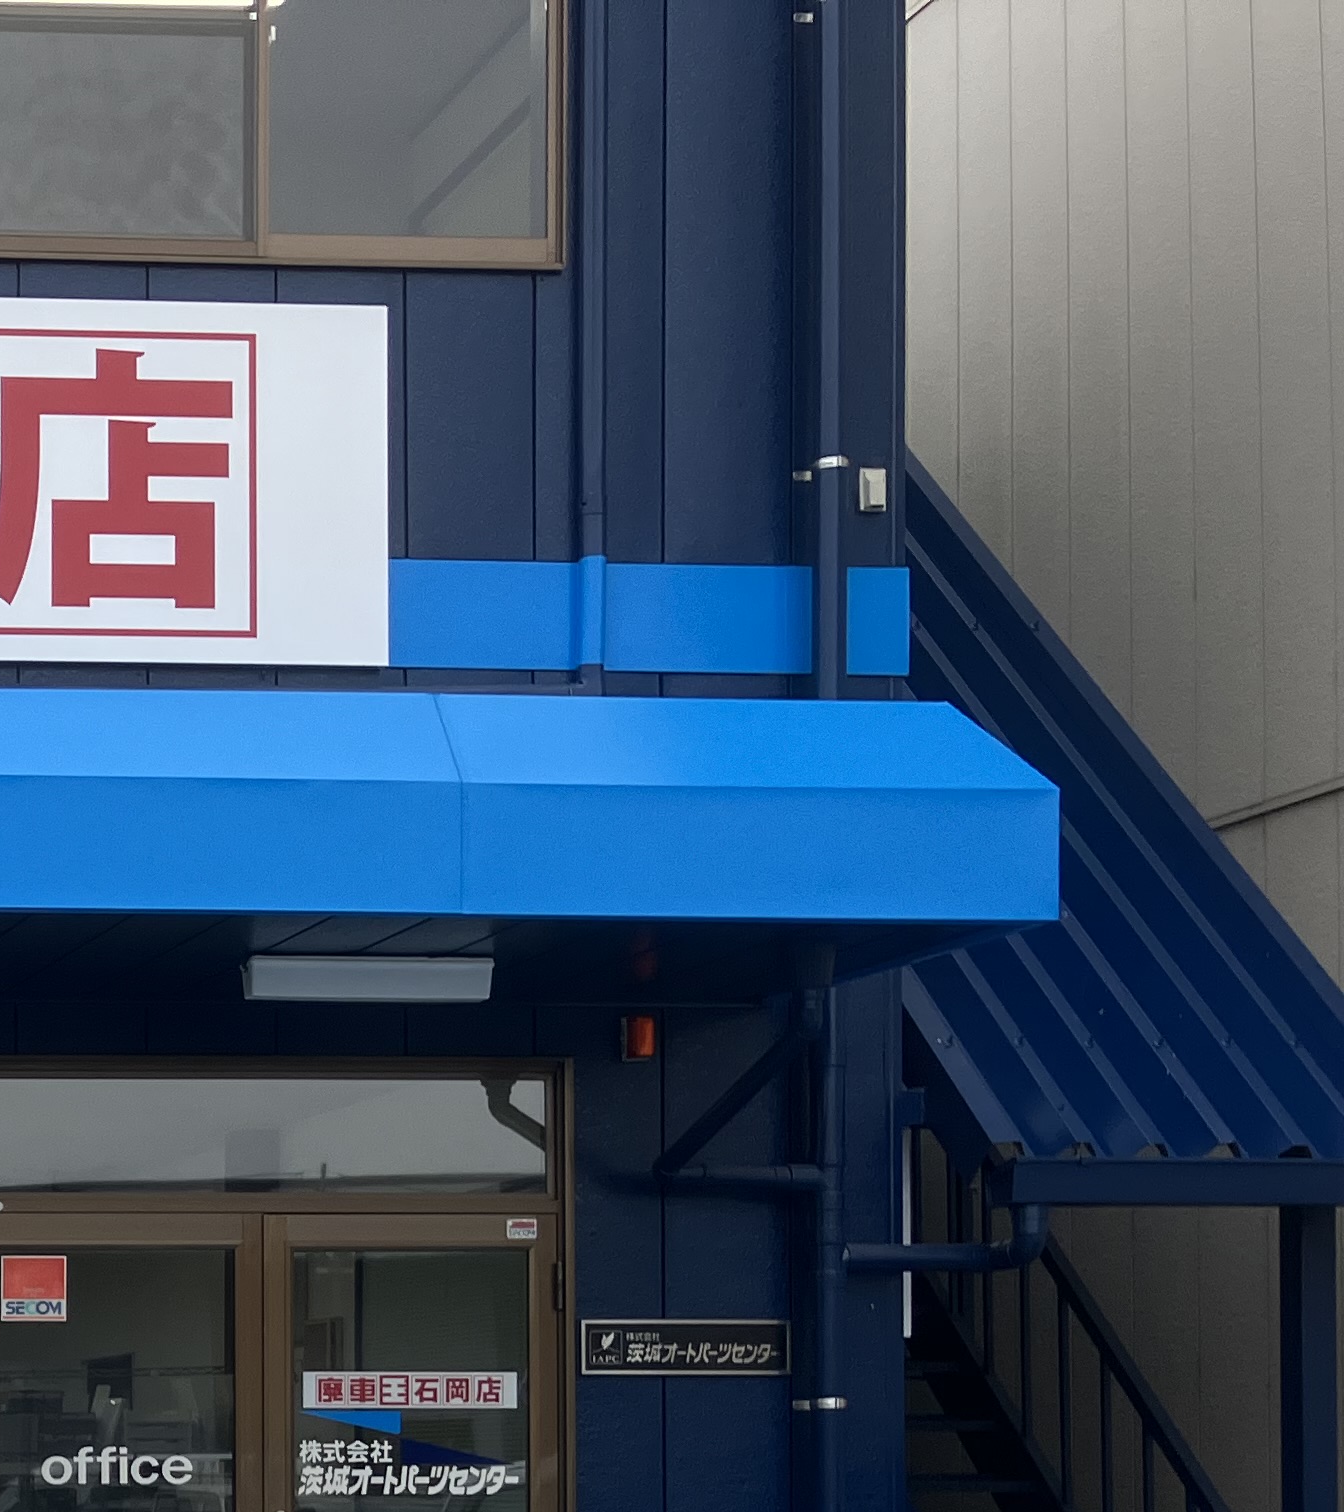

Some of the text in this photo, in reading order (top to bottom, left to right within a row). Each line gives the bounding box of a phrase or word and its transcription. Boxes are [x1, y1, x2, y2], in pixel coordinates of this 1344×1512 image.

[5, 1301, 62, 1315] SECOM
[626, 1342, 778, 1364] 茨城オートパーツセンター
[318, 1376, 502, 1404] 廃車王石岡店
[298, 1440, 393, 1463] 株式会社
[41, 1446, 193, 1485] office
[298, 1464, 519, 1495] 茨城オートパーツセンター
